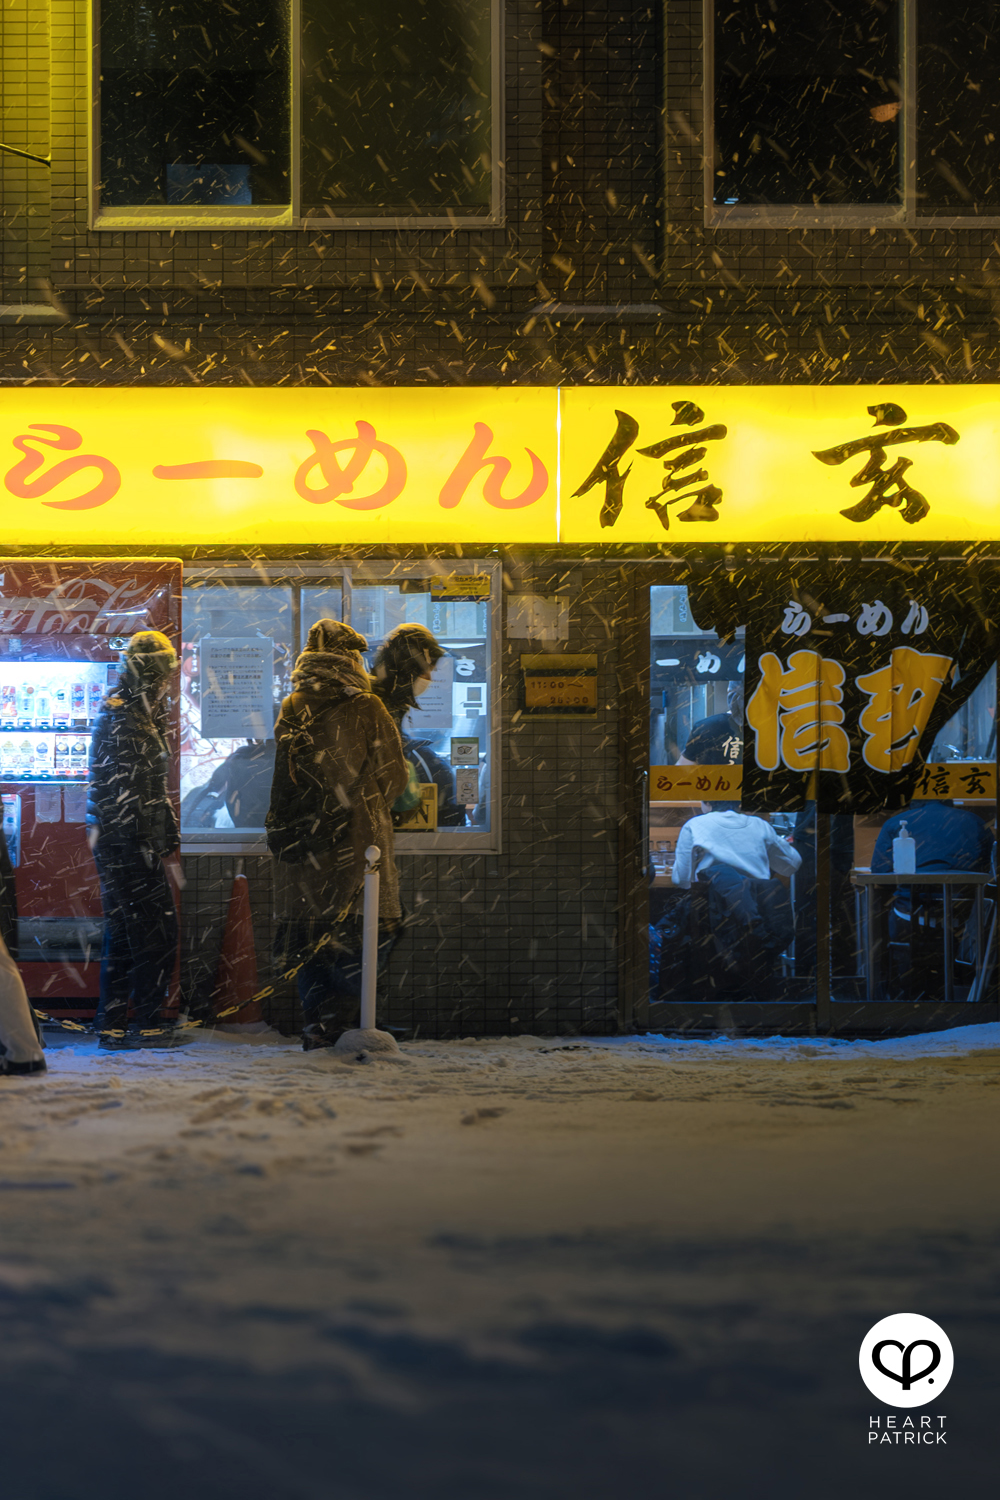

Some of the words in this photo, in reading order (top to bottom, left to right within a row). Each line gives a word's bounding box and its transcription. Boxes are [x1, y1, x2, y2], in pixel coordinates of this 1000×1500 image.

[4, 419, 549, 511] らーめん
[571, 400, 960, 531] 信玄
[780, 599, 930, 637] らーめん
[655, 651, 745, 673] ーめ
[915, 766, 992, 796] 信玄
